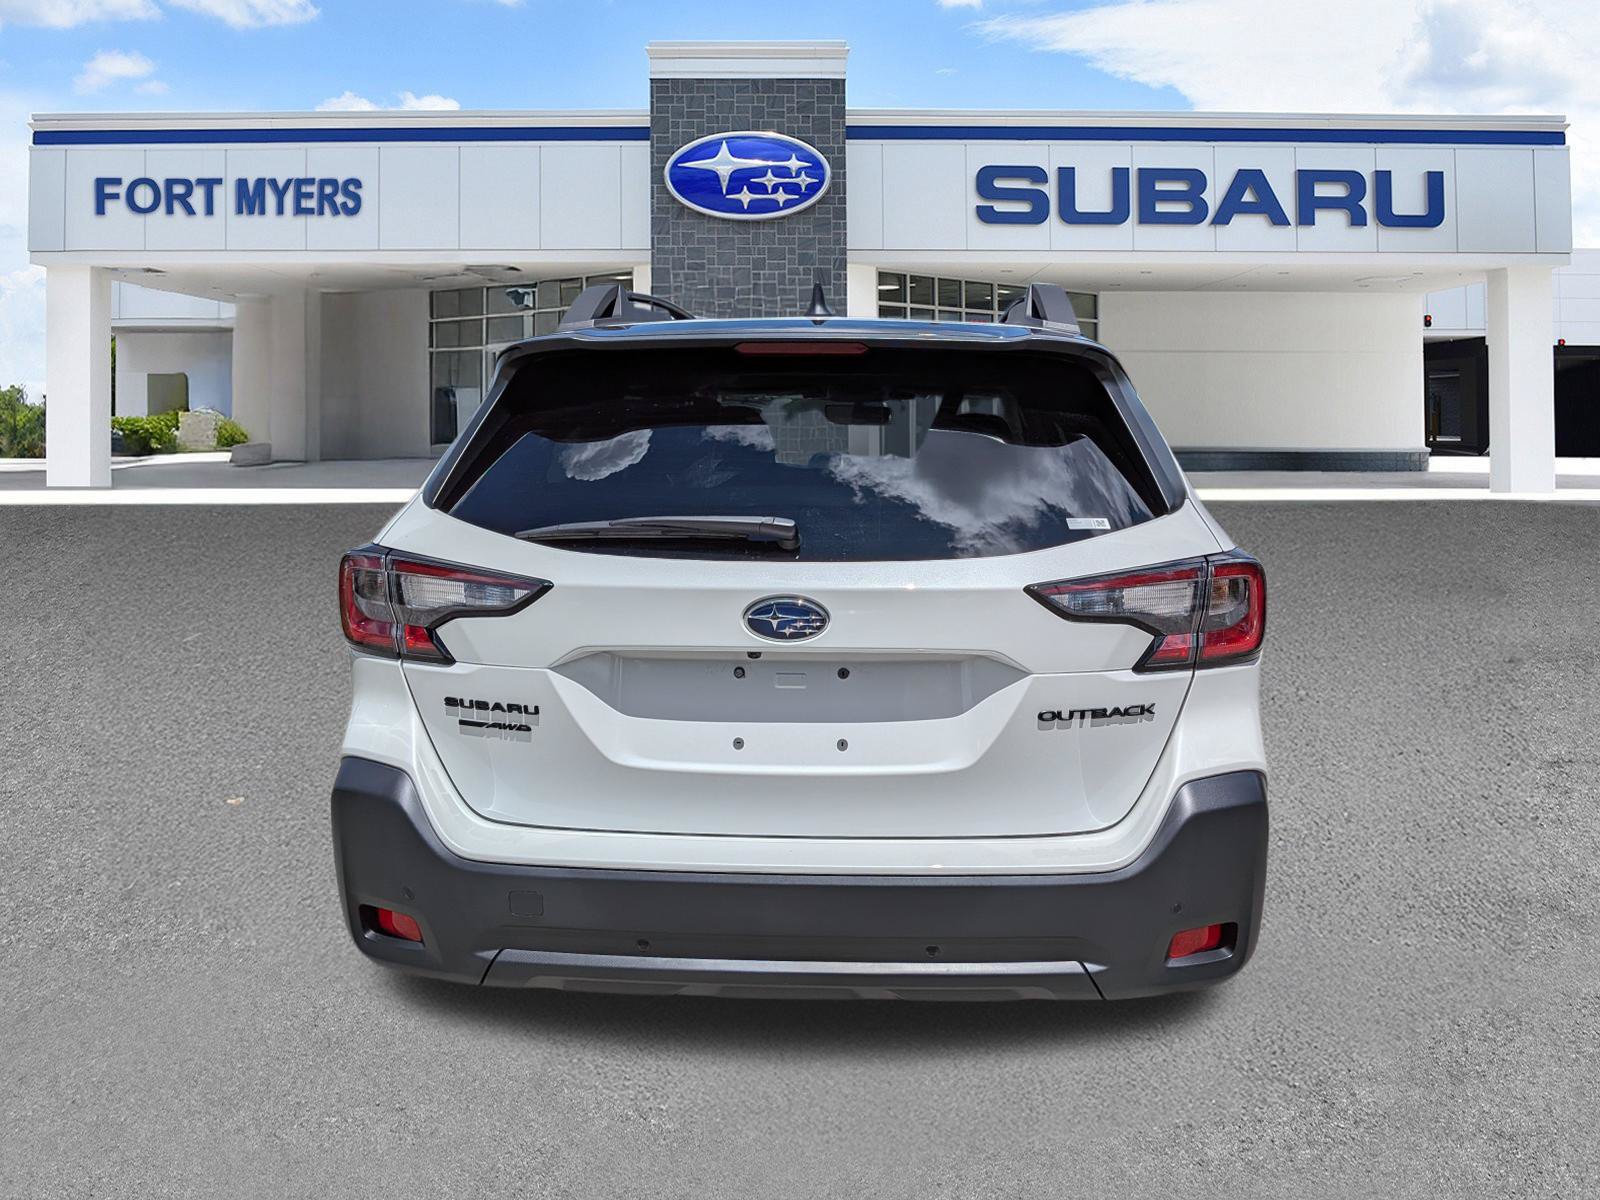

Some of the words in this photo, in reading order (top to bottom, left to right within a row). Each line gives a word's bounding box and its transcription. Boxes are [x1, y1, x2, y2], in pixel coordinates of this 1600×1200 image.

[95, 177, 223, 216] FORT
[235, 177, 363, 216] MYERS
[976, 165, 1445, 229] SUBARU
[444, 696, 540, 716] SUBARU
[1037, 703, 1156, 721] OUTBACK
